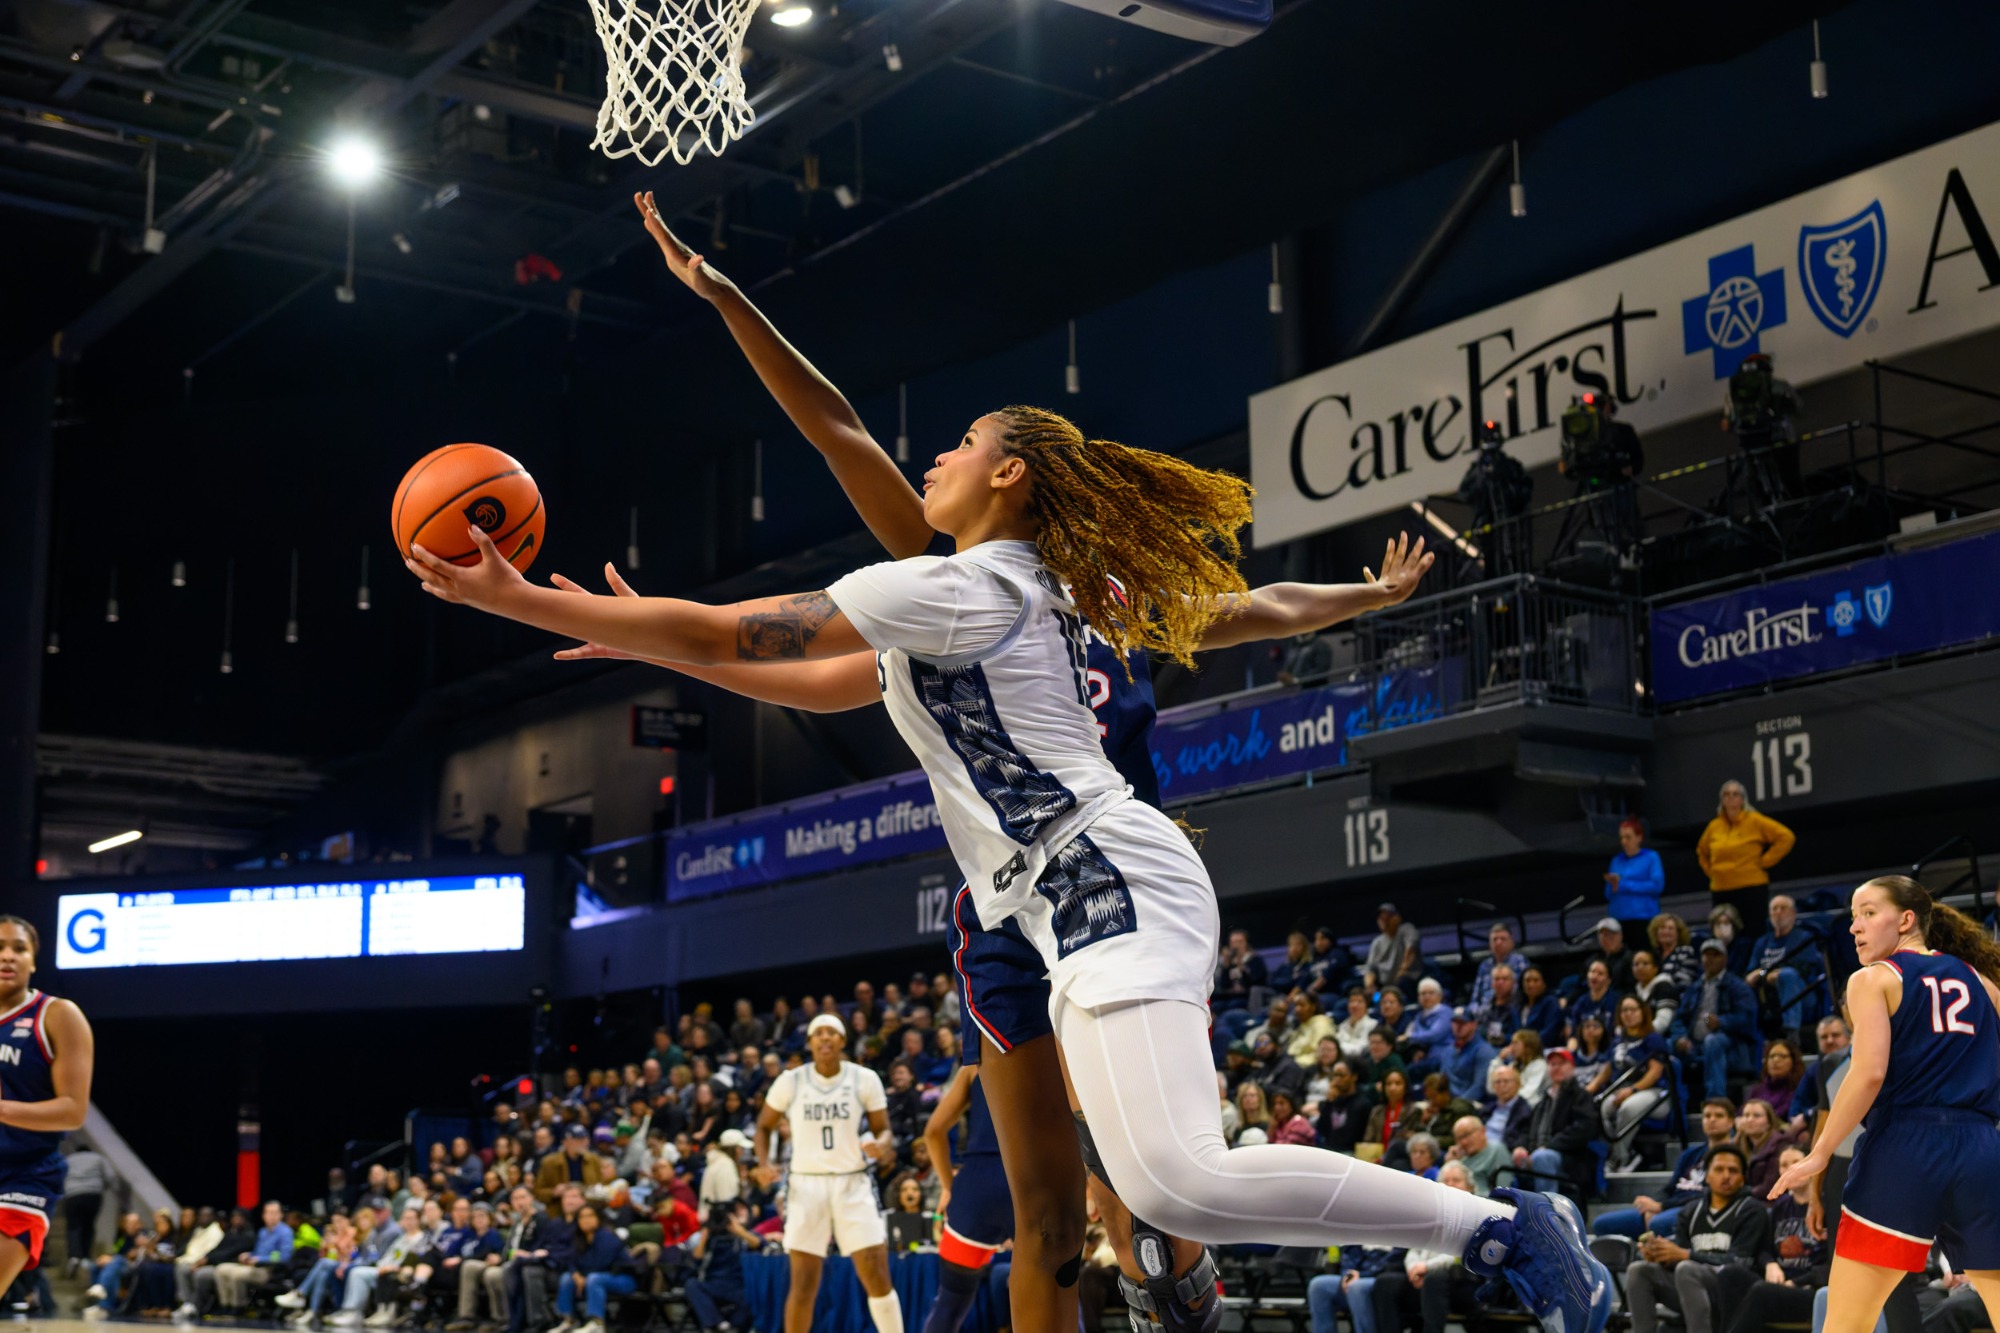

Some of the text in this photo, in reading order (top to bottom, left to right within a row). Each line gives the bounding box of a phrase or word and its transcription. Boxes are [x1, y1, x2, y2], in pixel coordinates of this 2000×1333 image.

[1289, 292, 1657, 502] CareFirst
[1678, 600, 1820, 669] CareFirst
[1175, 709, 1272, 776] work
[1279, 704, 1335, 753] and
[1755, 715, 1802, 735] SECTION
[1751, 732, 1813, 801] 113
[785, 820, 857, 857] Making
[859, 818, 873, 842] a
[1344, 808, 1390, 867] 113
[67, 908, 107, 955] G
[917, 887, 948, 933] 112
[1921, 975, 1976, 1035] 12
[803, 1103, 850, 1121] HOYAS
[822, 1126, 834, 1150] 0
